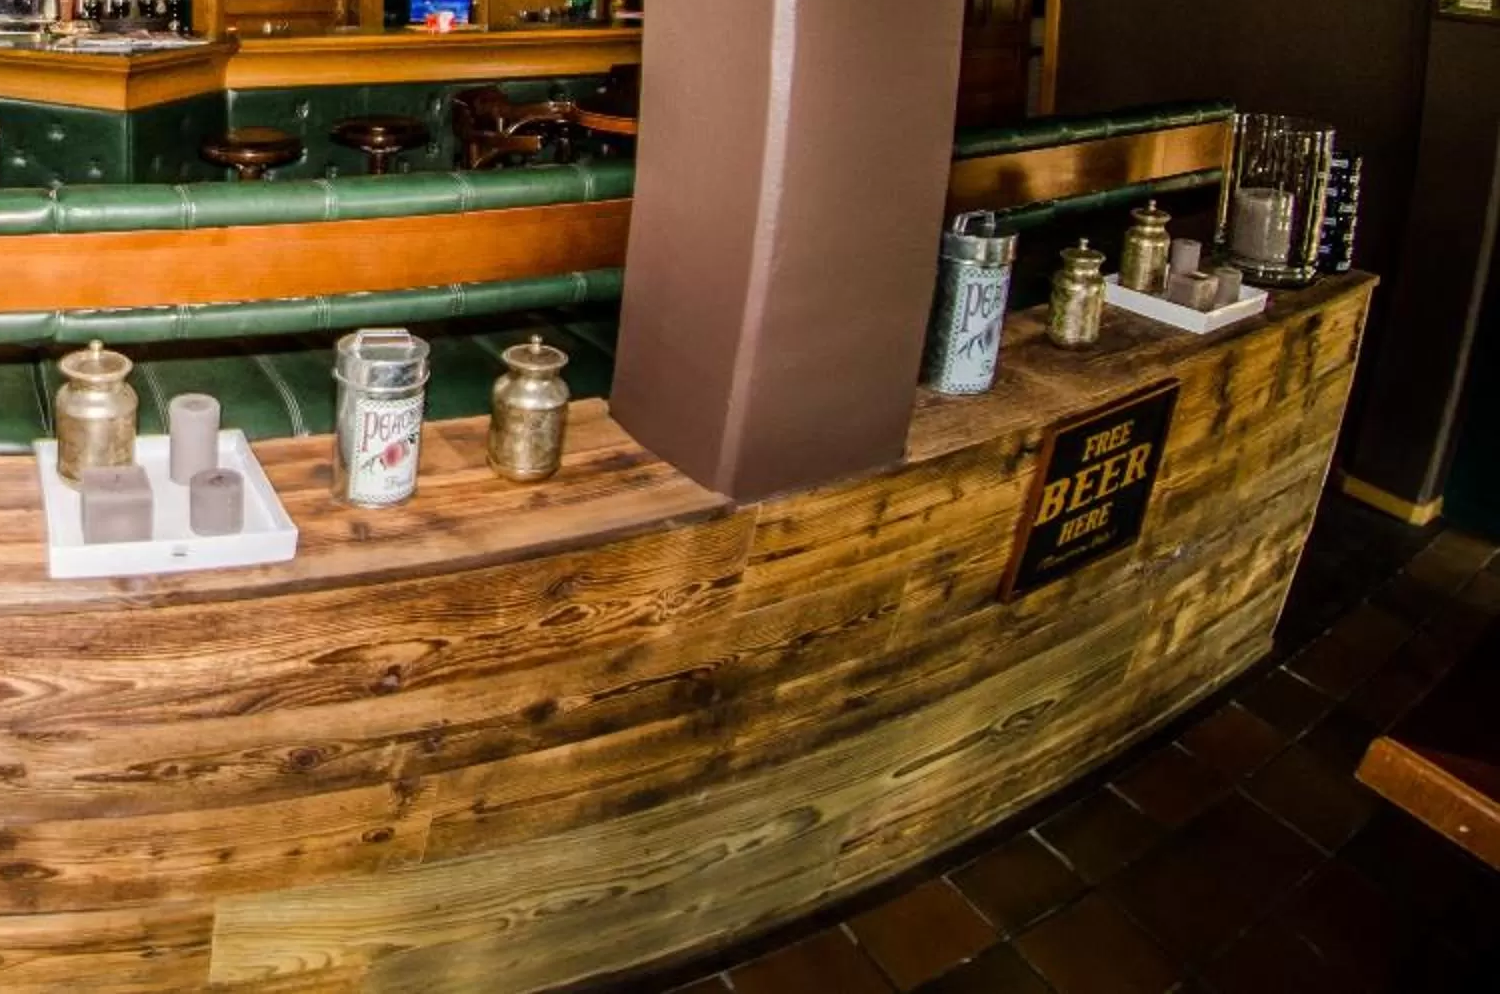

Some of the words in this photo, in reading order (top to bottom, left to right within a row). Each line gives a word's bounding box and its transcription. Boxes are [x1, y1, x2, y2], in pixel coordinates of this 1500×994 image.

[1081, 419, 1135, 463] FREE
[1032, 442, 1153, 527] BEER
[1056, 502, 1115, 547] HERE
